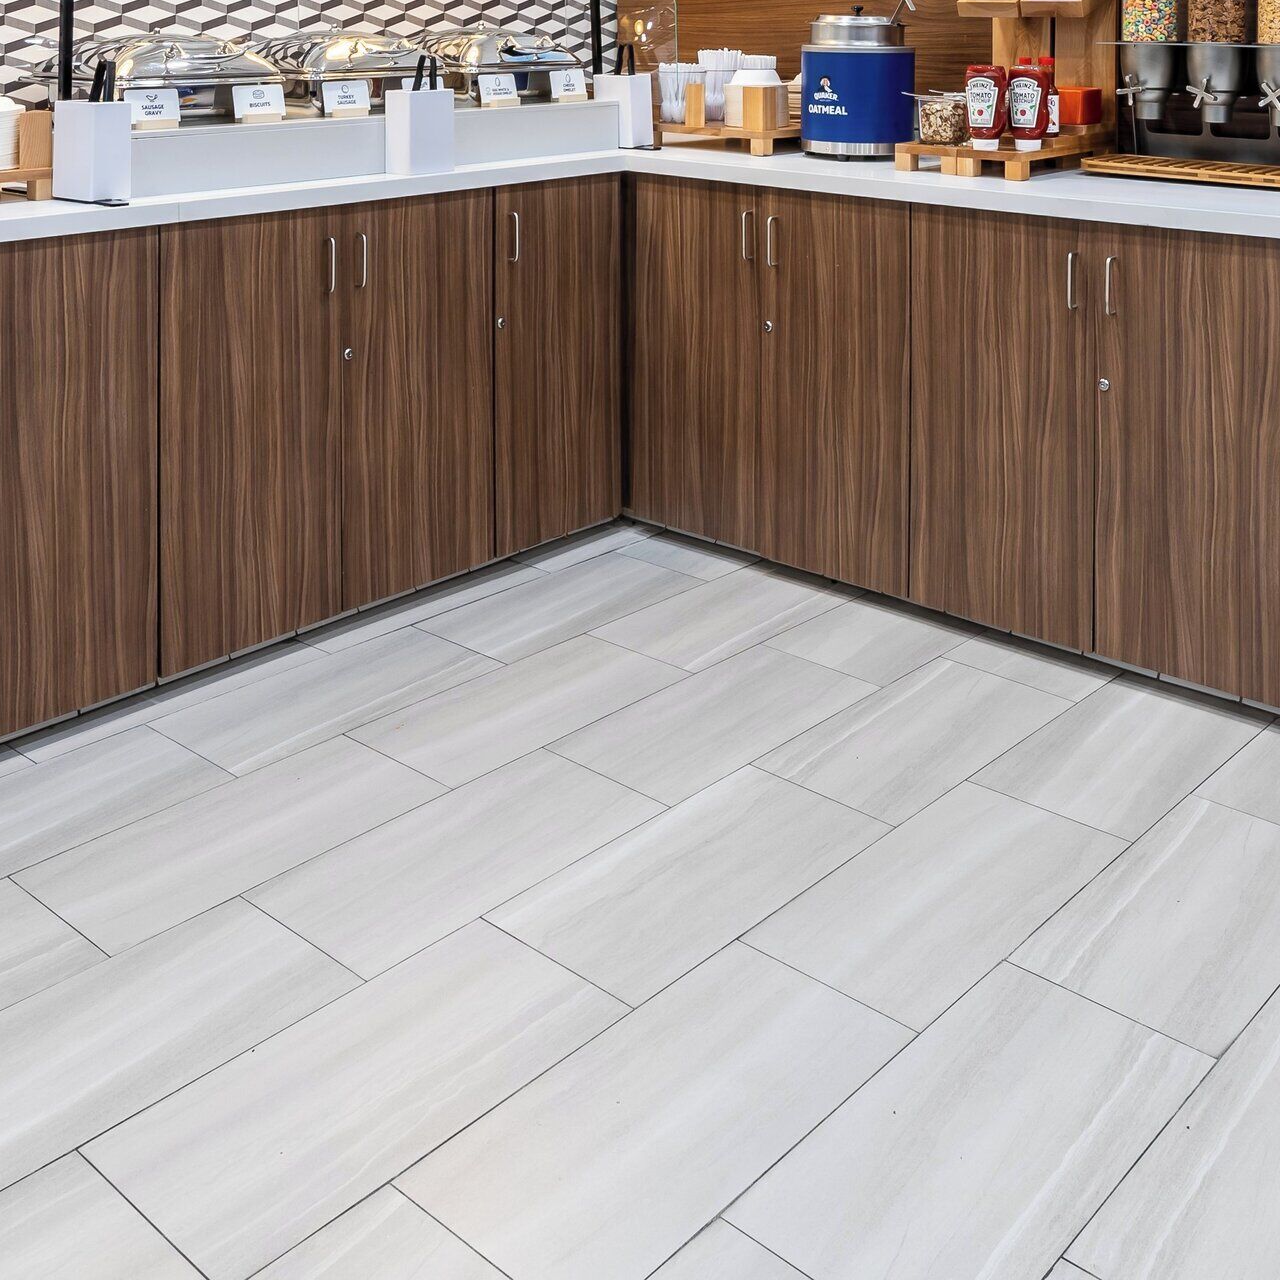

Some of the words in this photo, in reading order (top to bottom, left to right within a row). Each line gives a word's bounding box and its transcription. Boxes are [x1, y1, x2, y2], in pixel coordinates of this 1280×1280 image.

[813, 92, 838, 100] QUAKER
[1013, 91, 1035, 99] TOMATO
[141, 103, 165, 111] SAUSAGE
[808, 103, 848, 116] OATMEAL
